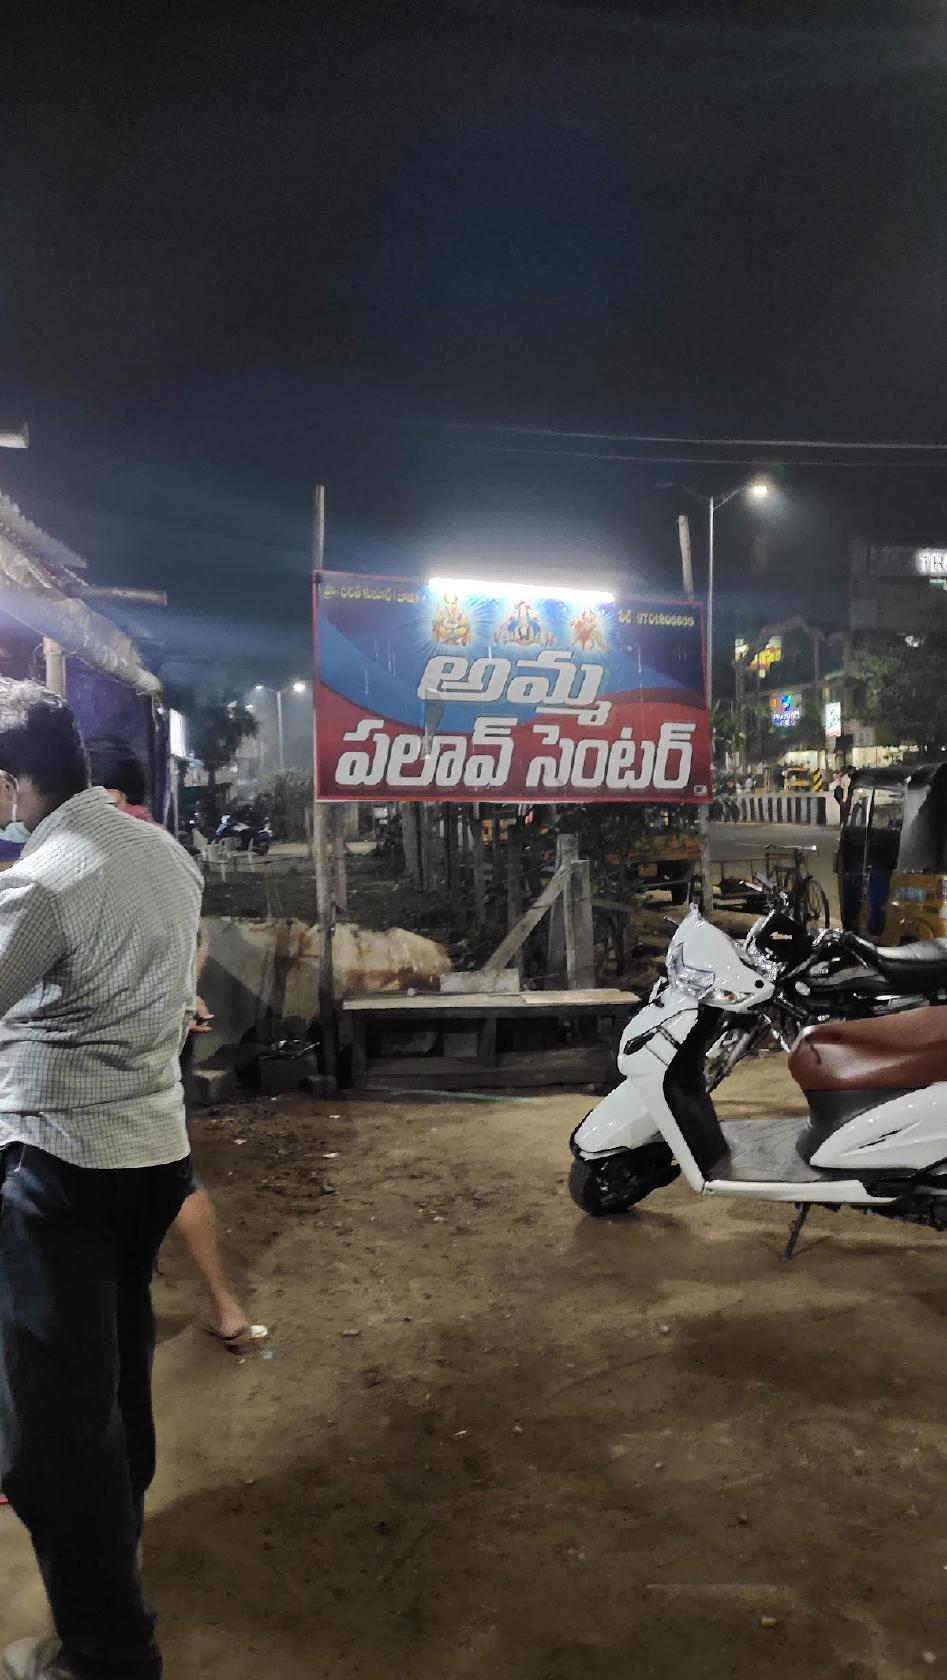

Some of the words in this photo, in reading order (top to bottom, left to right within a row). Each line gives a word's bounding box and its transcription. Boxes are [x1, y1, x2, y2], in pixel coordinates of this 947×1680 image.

[416, 650, 612, 726] అమ్మ
[335, 716, 518, 787] పలావ్
[525, 722, 697, 790] సెంటర్
